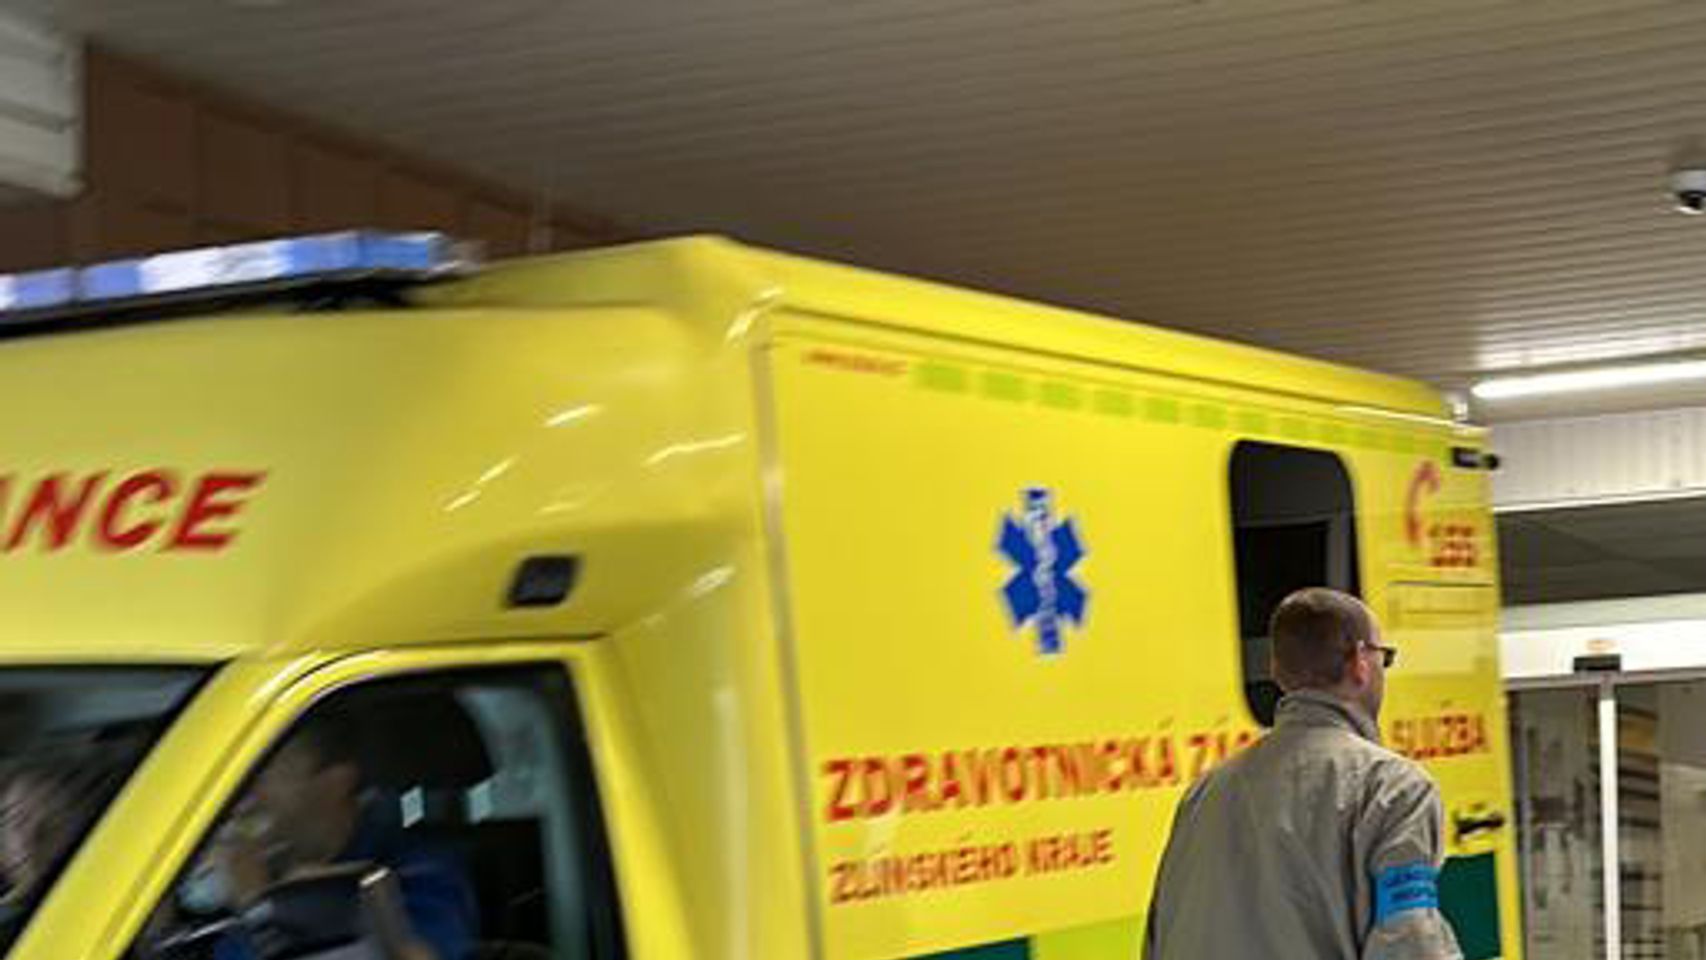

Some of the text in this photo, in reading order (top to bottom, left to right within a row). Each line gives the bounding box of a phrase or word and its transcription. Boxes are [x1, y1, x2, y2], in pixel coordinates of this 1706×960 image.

[0, 467, 269, 553] NCE
[822, 717, 1179, 822] ZDRAVOTNICKÁ
[829, 828, 1116, 905] ZLÍNSKÉHO KRAJE
